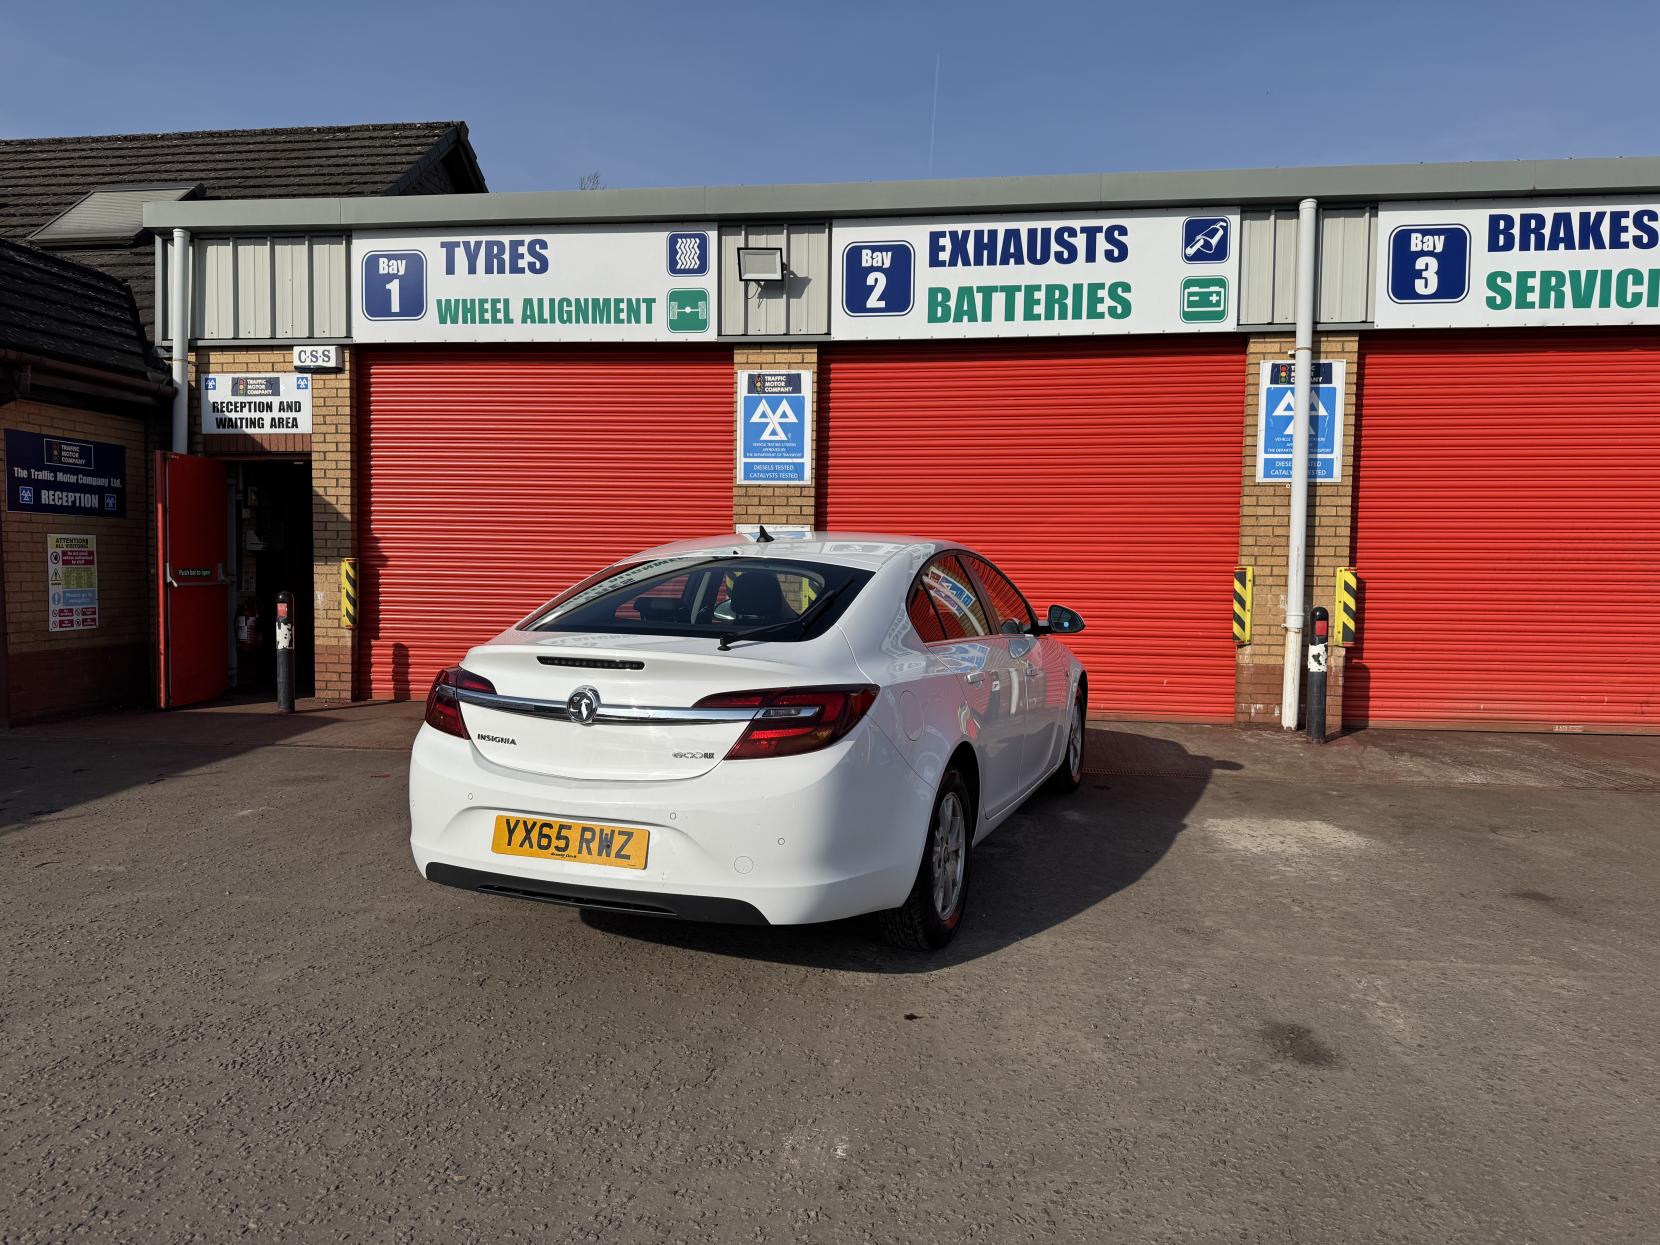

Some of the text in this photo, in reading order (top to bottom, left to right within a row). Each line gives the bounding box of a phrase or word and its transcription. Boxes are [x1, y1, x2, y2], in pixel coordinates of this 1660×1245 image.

[1410, 232, 1444, 252] Bay
[1488, 209, 1659, 252] BRAKES
[440, 238, 549, 276] TYRES
[928, 224, 1129, 268] EXHAUSTS
[378, 257, 406, 276] Bay
[861, 249, 892, 269] Bay
[1414, 256, 1438, 296] 3
[385, 278, 400, 312] 1
[865, 271, 887, 308] 2
[436, 298, 656, 325] WHEEL ALIGNMENT
[927, 281, 1132, 324] BATTERIES
[212, 401, 301, 413] RECEPTION AND
[215, 417, 299, 429] WAITING AREA
[61, 456, 86, 465] COMPANY
[14, 467, 28, 478] The
[30, 469, 54, 481] Traffic
[57, 472, 77, 483] Motor
[78, 474, 108, 487] Company
[41, 490, 99, 508] RECEPTION
[477, 734, 517, 745] INSIGNIA
[505, 818, 633, 860] YX65 RWZ
